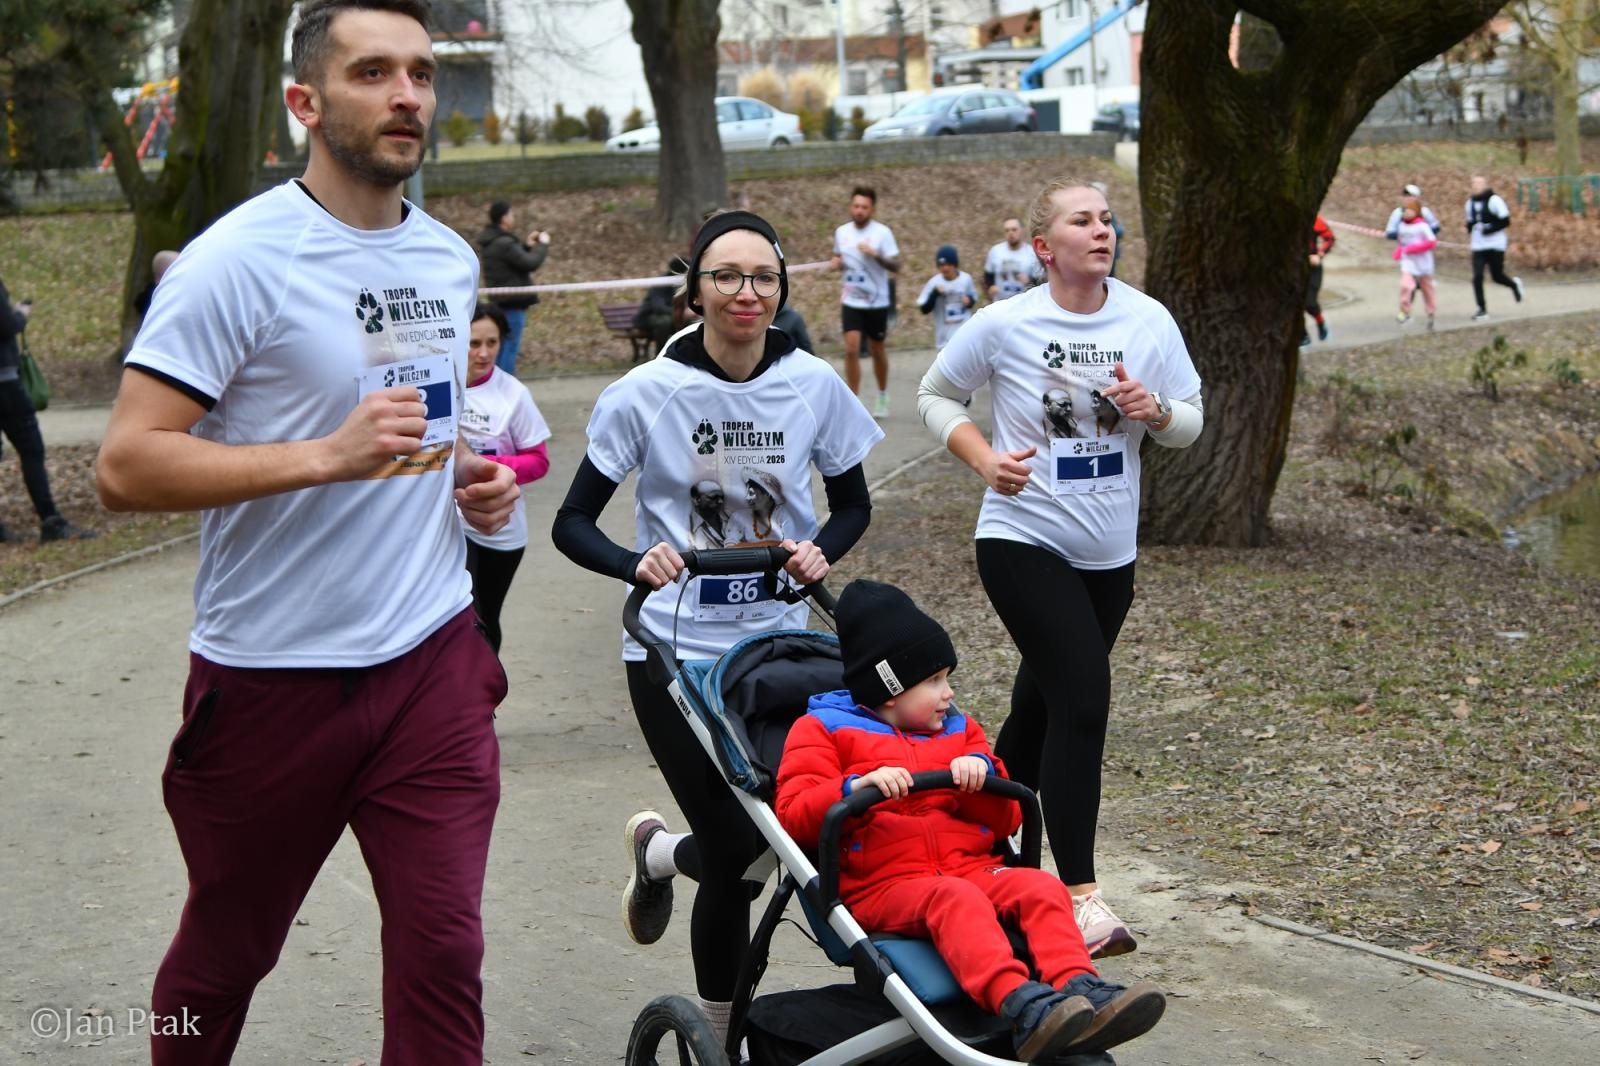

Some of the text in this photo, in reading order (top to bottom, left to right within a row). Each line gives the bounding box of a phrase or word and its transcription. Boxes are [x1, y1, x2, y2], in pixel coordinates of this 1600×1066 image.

[383, 287, 417, 301] TROPEM
[387, 299, 450, 322] WILCZYM
[395, 327, 456, 343] XIV EDYCJA 2026
[1068, 342, 1097, 351] TROPEM
[1070, 350, 1124, 363] WILCZYM
[398, 365, 415, 373] TROPEM
[398, 369, 431, 383] WILCZYM
[721, 421, 754, 431] TROPEM
[723, 432, 784, 447] WILCZYM
[724, 455, 786, 465] XIV EDYCJA 2026
[1088, 457, 1099, 477] 1
[727, 579, 759, 603] 86
[677, 695, 692, 718] THULE
